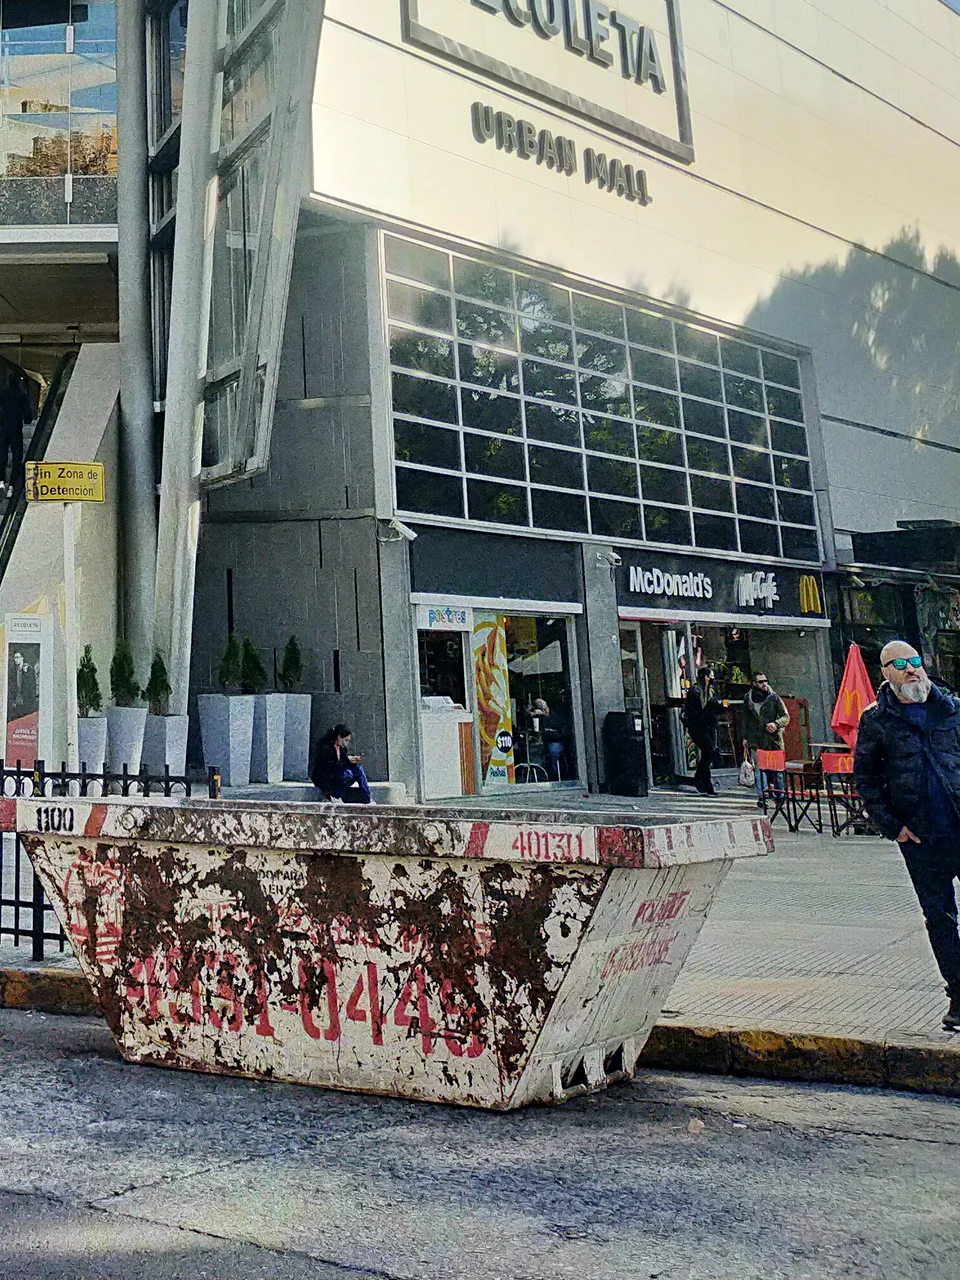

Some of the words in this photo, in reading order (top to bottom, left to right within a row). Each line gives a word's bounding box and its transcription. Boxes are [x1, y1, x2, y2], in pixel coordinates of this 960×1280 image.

[470, 101, 578, 176] URBAN
[583, 147, 654, 207] MALL
[32, 467, 51, 479] in
[58, 467, 84, 480] Zona
[87, 469, 98, 480] de
[40, 484, 94, 496] Detención
[629, 565, 713, 599] McDonald's
[428, 607, 467, 627] postres
[497, 735, 513, 748] $110
[36, 806, 74, 832] 1100
[512, 831, 583, 861] 40130
